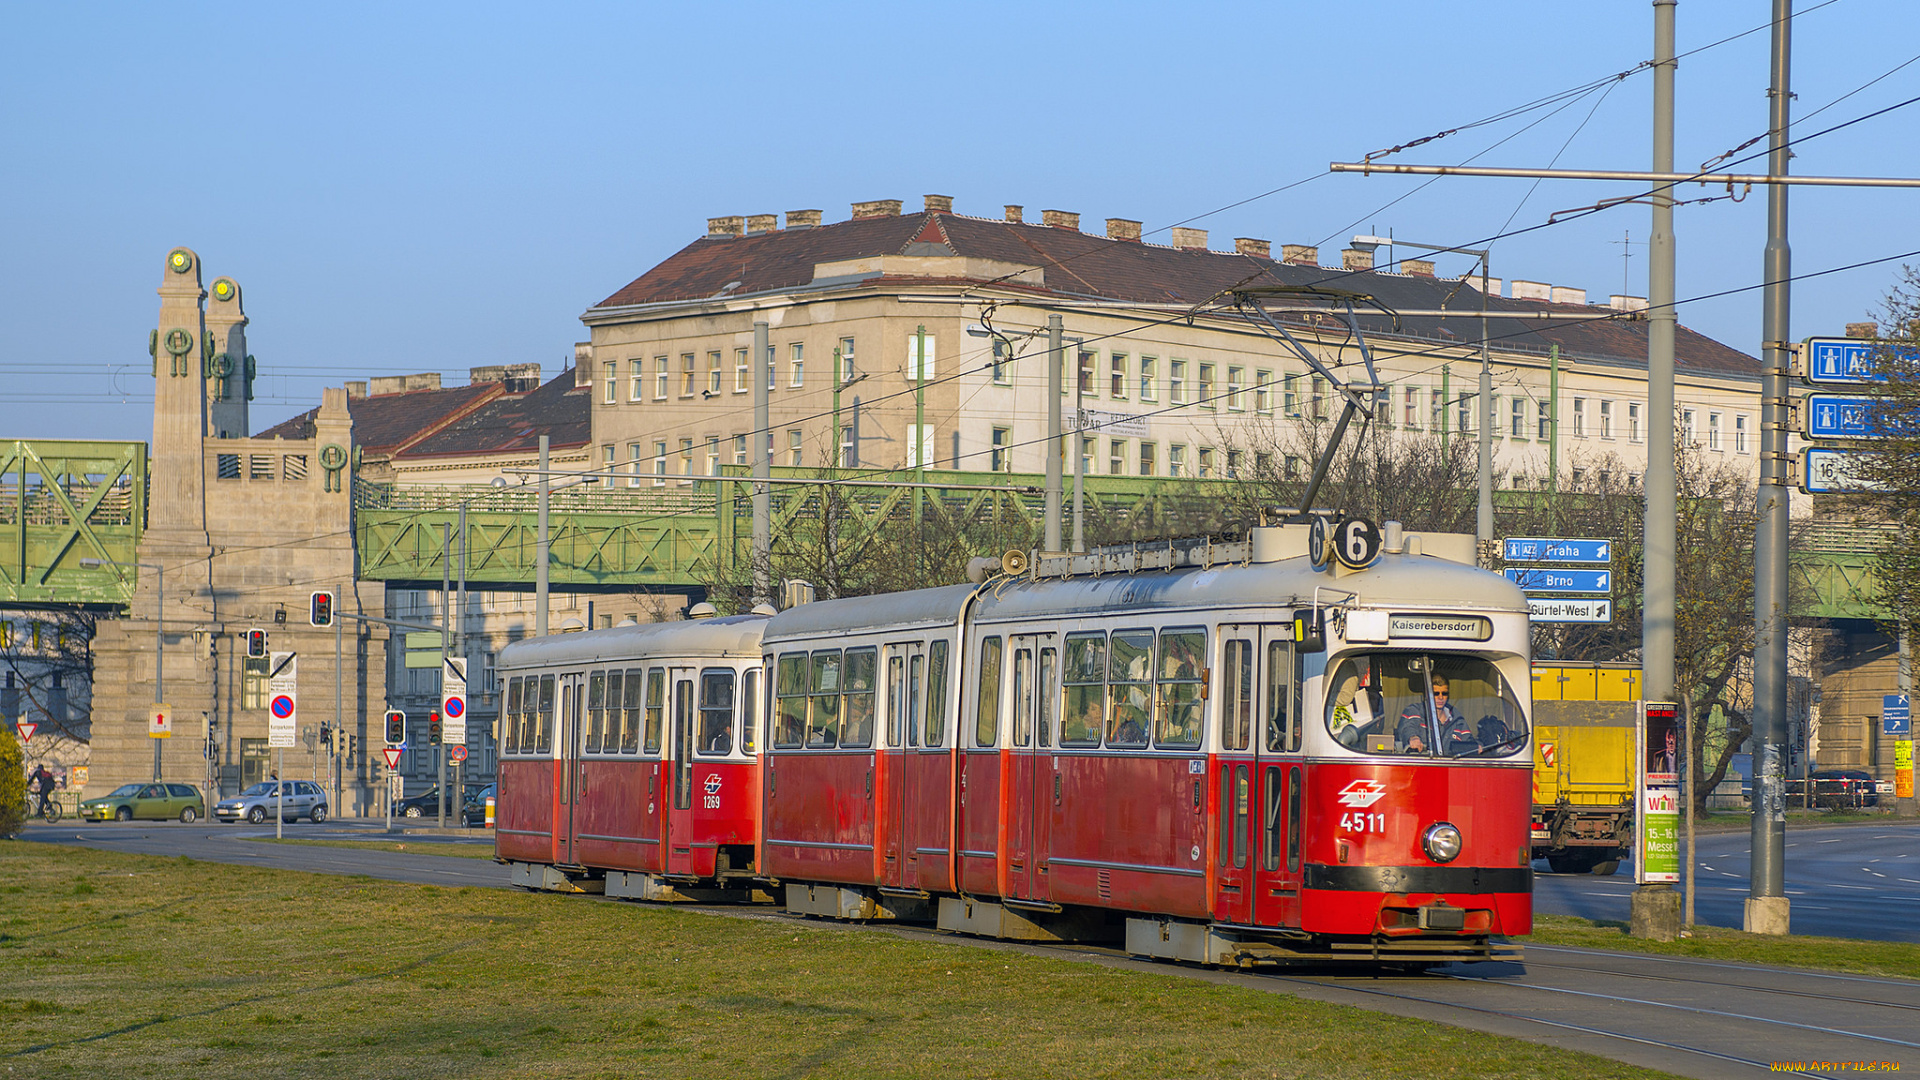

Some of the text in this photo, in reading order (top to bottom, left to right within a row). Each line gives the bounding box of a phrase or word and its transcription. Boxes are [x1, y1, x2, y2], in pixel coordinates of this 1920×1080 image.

[1820, 463, 1834, 478] 16
[1313, 521, 1322, 560] 6
[1346, 520, 1368, 561] 6
[1546, 545, 1580, 556] Praha
[1546, 575, 1574, 586] Brno
[1531, 604, 1590, 616] Gürtel-West
[1392, 620, 1476, 632] Kaiserebersdorf
[703, 795, 720, 809] 1269
[1340, 812, 1385, 833] 4511
